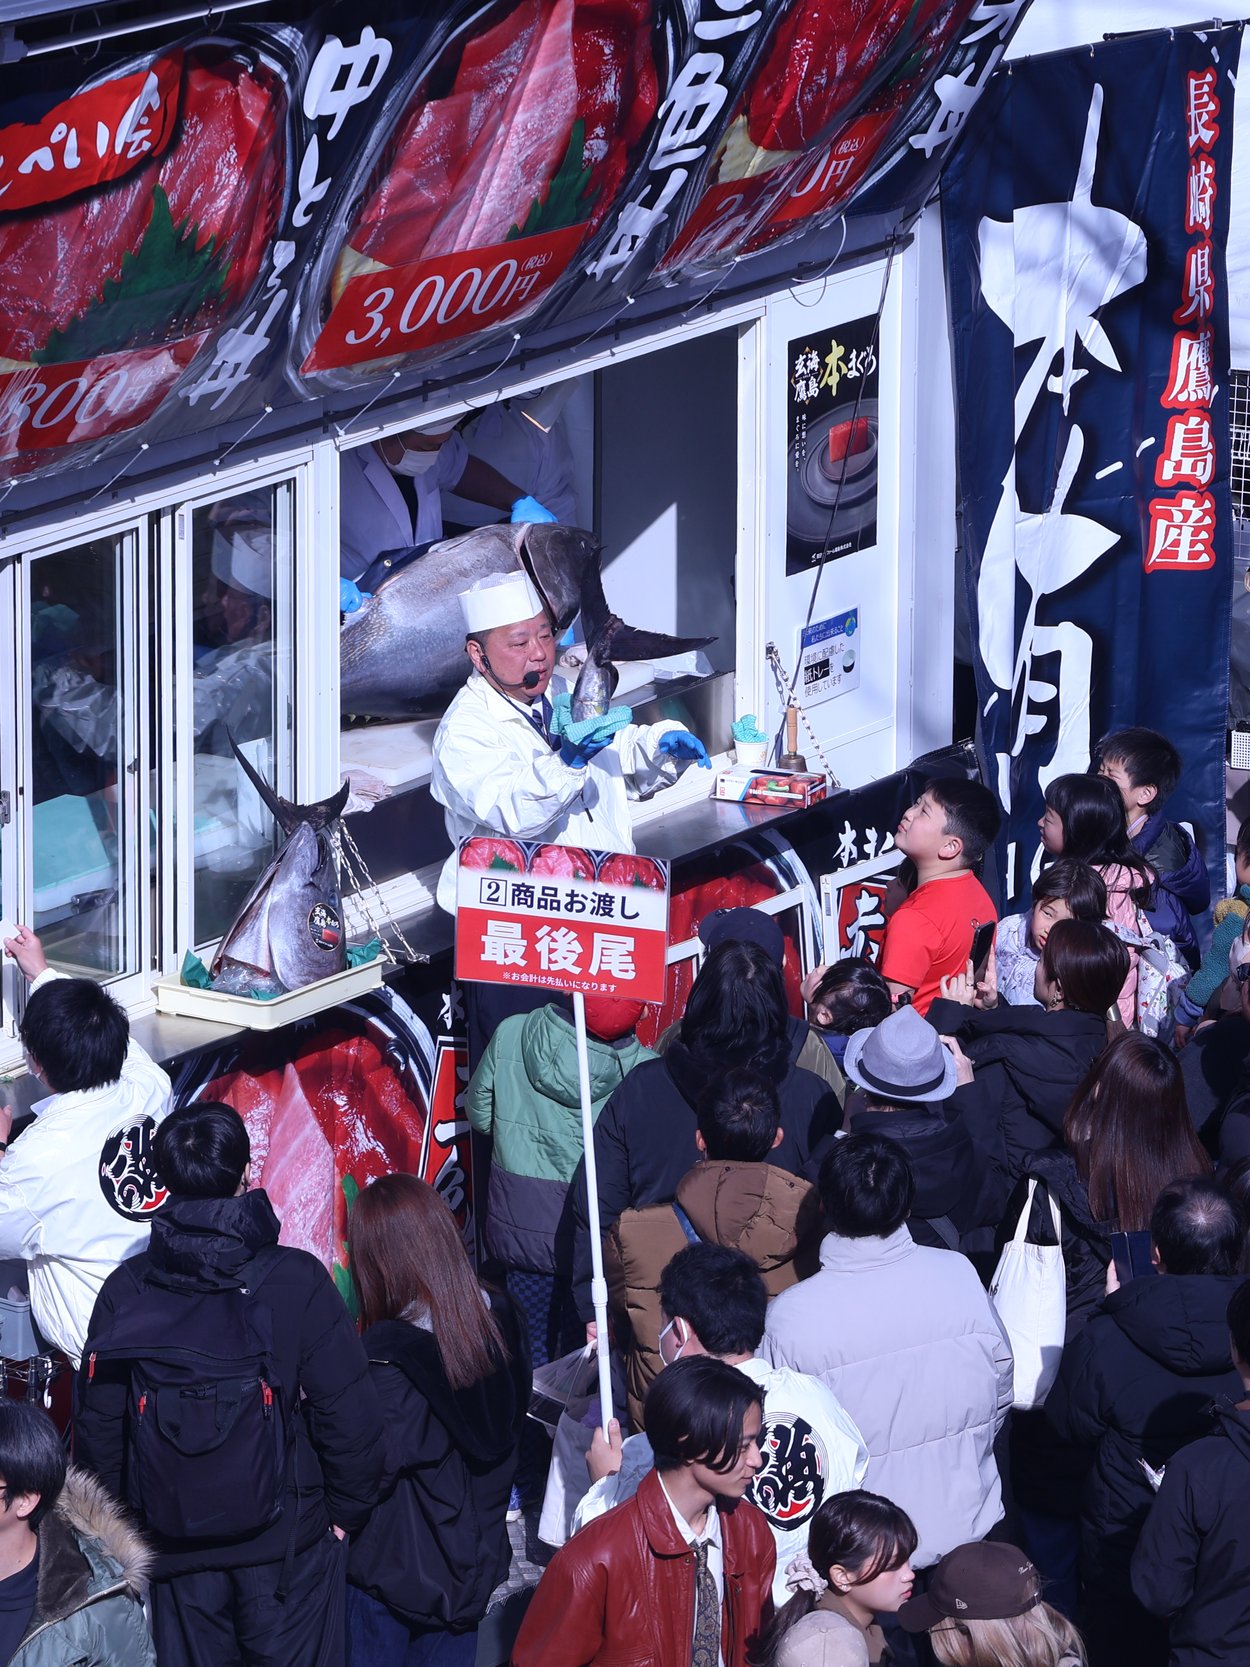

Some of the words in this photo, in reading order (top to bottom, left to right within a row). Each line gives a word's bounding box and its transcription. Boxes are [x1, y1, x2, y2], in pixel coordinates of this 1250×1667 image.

[178, 25, 393, 410] 中とろ丼
[345, 258, 538, 346] 3,000円
[1147, 76, 1218, 568] 長崎県鷹島産
[511, 883, 640, 920] 商品お渡し
[480, 919, 637, 980] 最後尾
[502, 971, 617, 992] ※お会計は先払いになります
